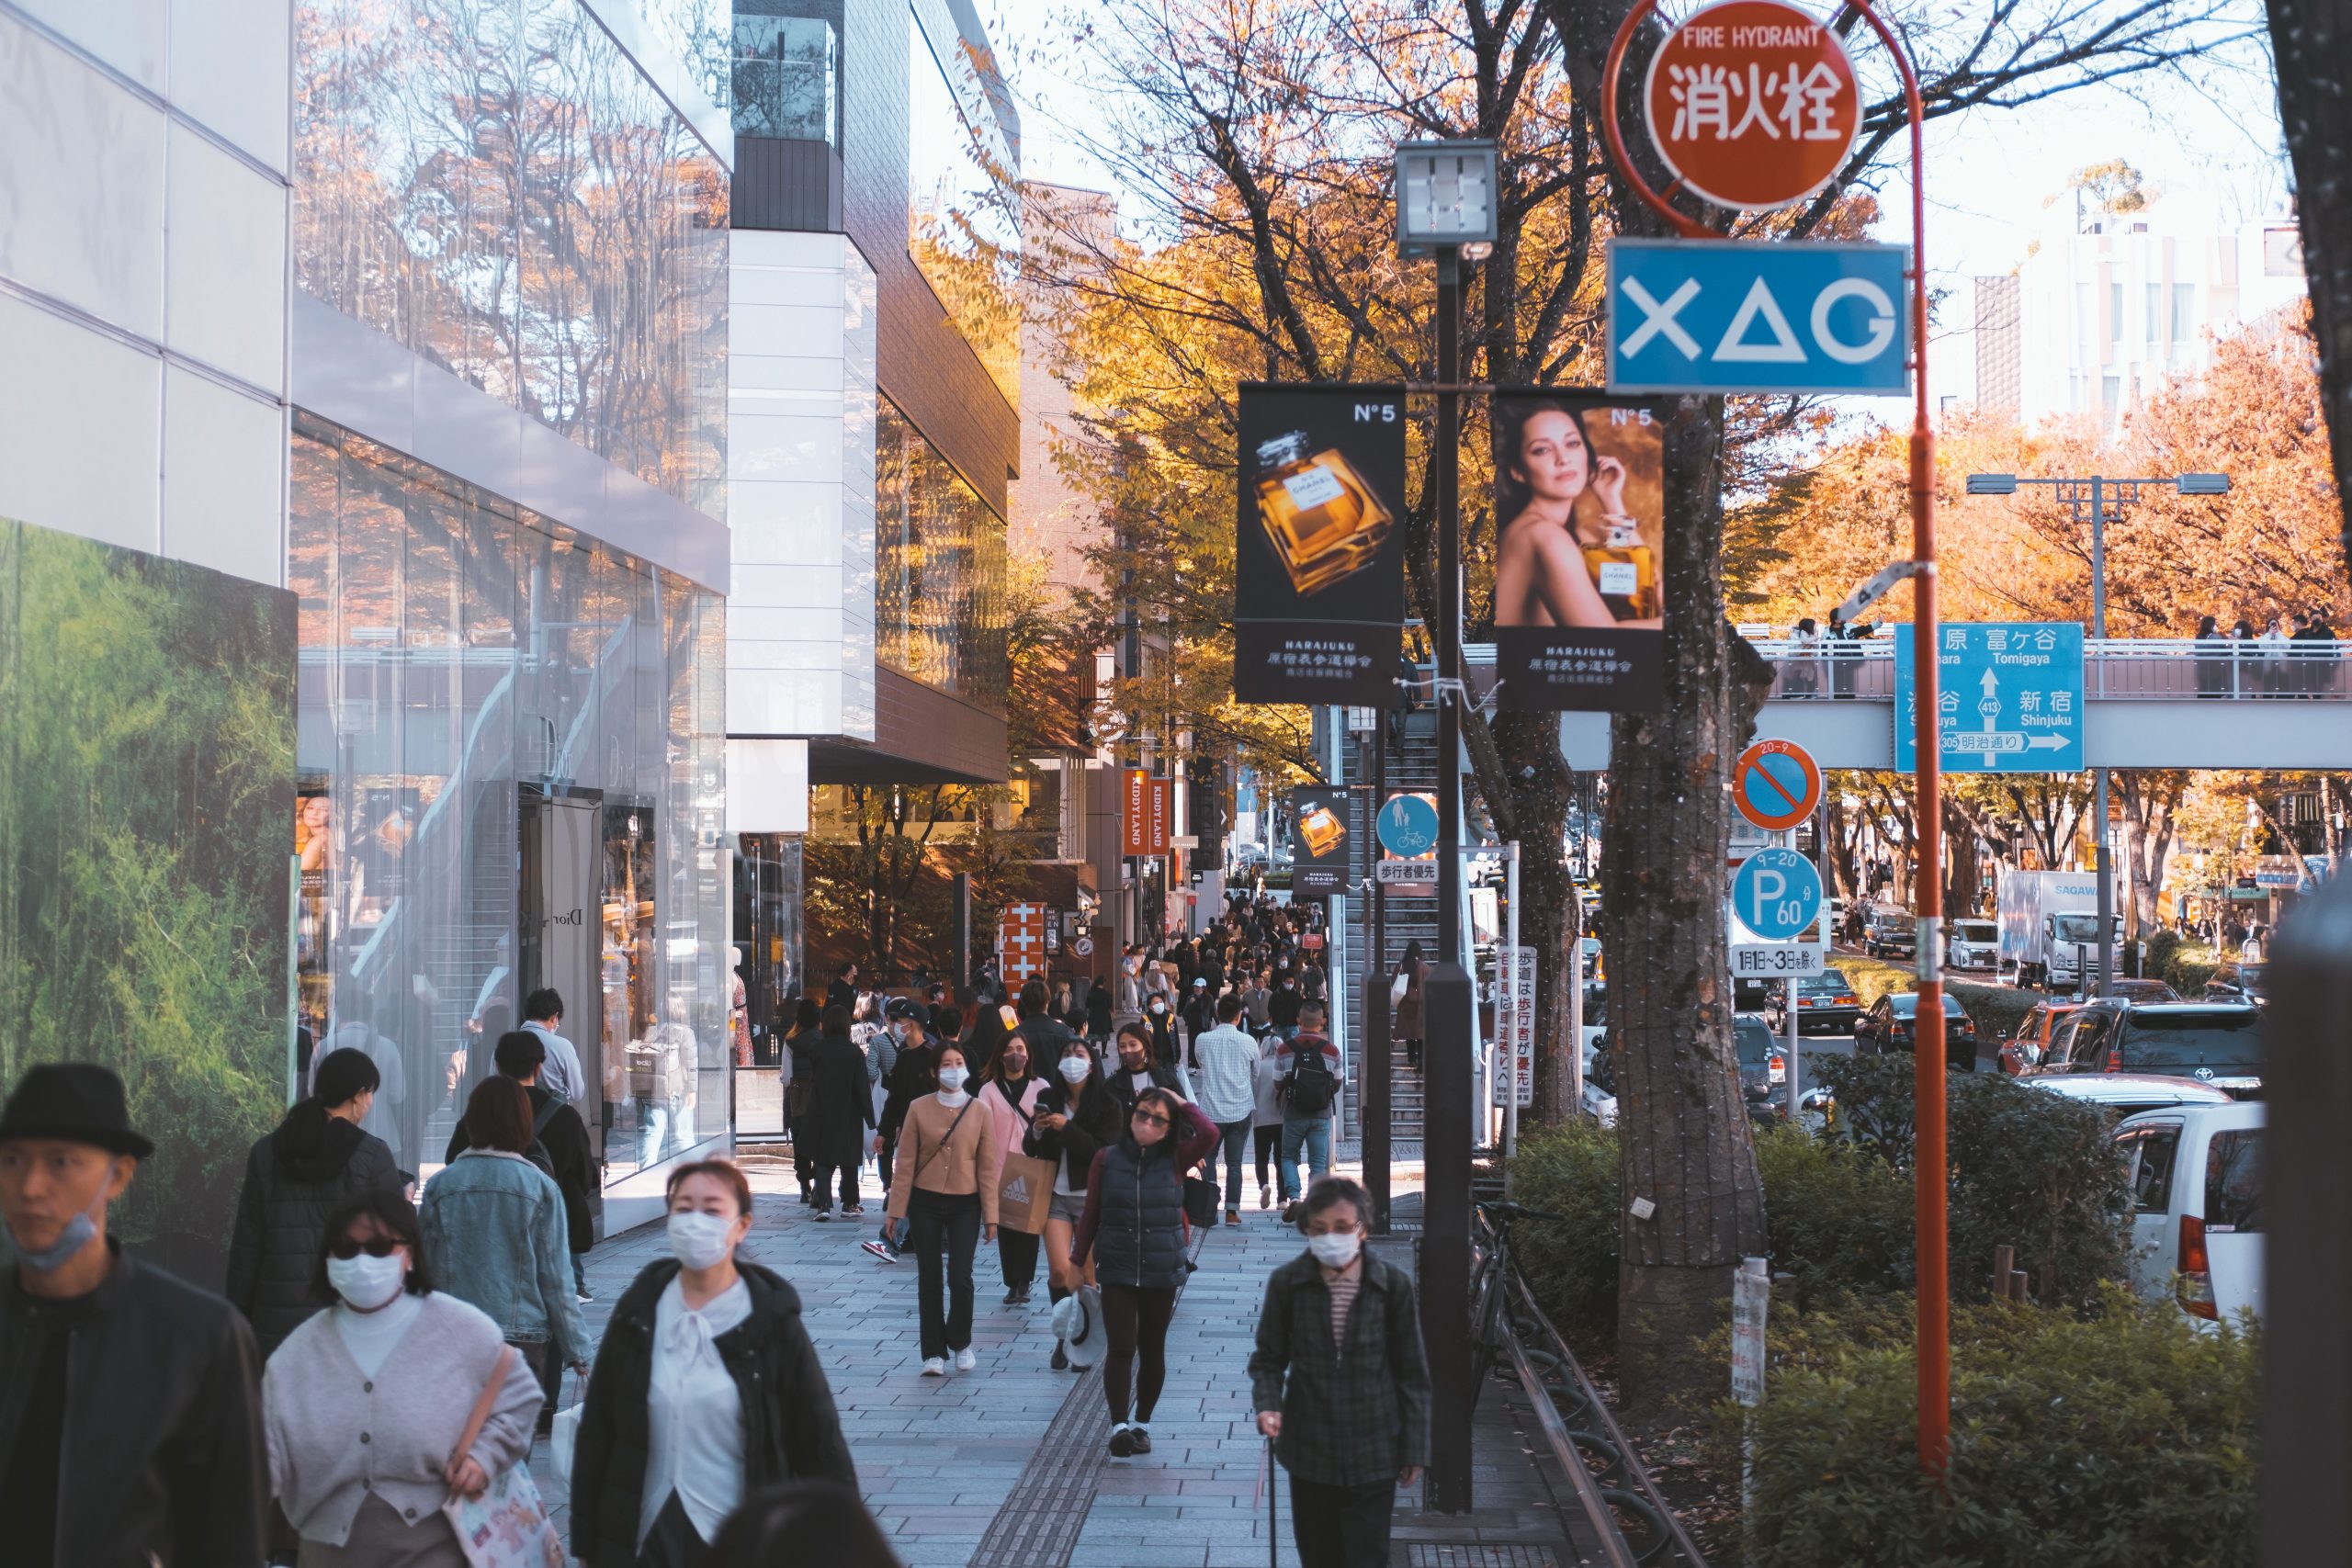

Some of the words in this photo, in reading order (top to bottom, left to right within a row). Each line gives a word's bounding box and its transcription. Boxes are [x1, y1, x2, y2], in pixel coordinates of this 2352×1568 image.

[1683, 28, 1724, 48] FIRE
[1732, 27, 1820, 48] HYDRANT
[1669, 62, 1841, 141] 消火栓
[1285, 640, 1355, 651] HARAJUKU
[1546, 647, 1615, 657] HARAJUKU
[1993, 652, 2050, 666] Tomigaya
[1982, 702, 1998, 713] 413
[2019, 691, 2072, 712] 新宿
[2021, 714, 2072, 728] Shinjuku
[1759, 742, 1789, 754] 20-9
[1941, 737, 1958, 748] 305
[1962, 736, 2017, 749] 明治通り
[1757, 852, 1797, 867] 9-20
[1381, 865, 1435, 878] 歩行者優先
[1753, 870, 1786, 926] P
[1777, 900, 1801, 925] 60
[2055, 886, 2098, 896] SAGAW
[1517, 953, 1532, 1086] 歩道は歩行者が優先
[1001, 1190, 1030, 1205] adidas
